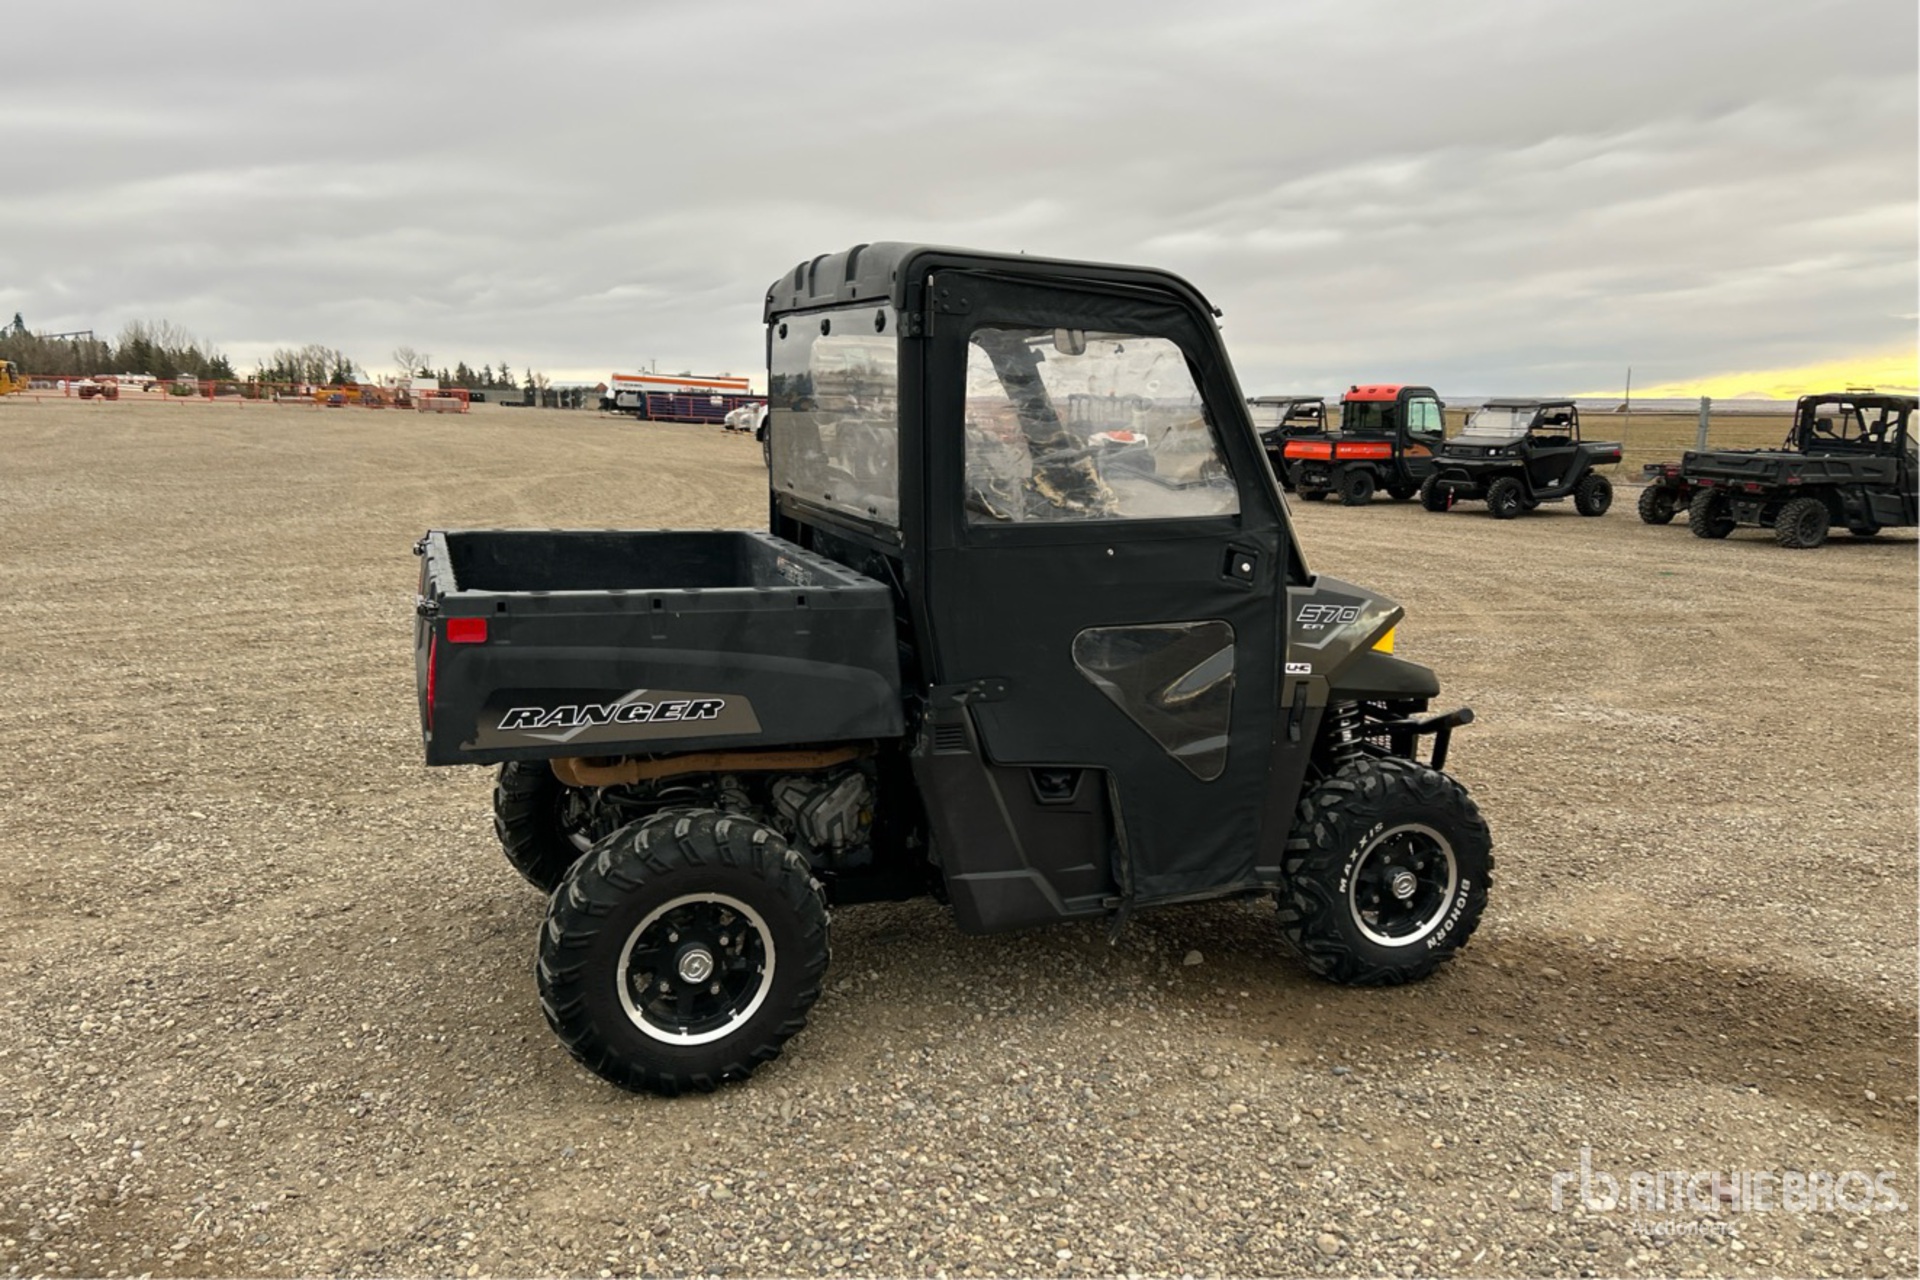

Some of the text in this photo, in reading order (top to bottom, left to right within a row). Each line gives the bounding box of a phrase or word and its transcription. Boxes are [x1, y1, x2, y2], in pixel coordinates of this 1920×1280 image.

[1296, 604, 1360, 624] 570
[497, 698, 725, 729] RANGER
[1339, 822, 1384, 893] MAXXIS
[1427, 878, 1471, 949] BIGHORN
